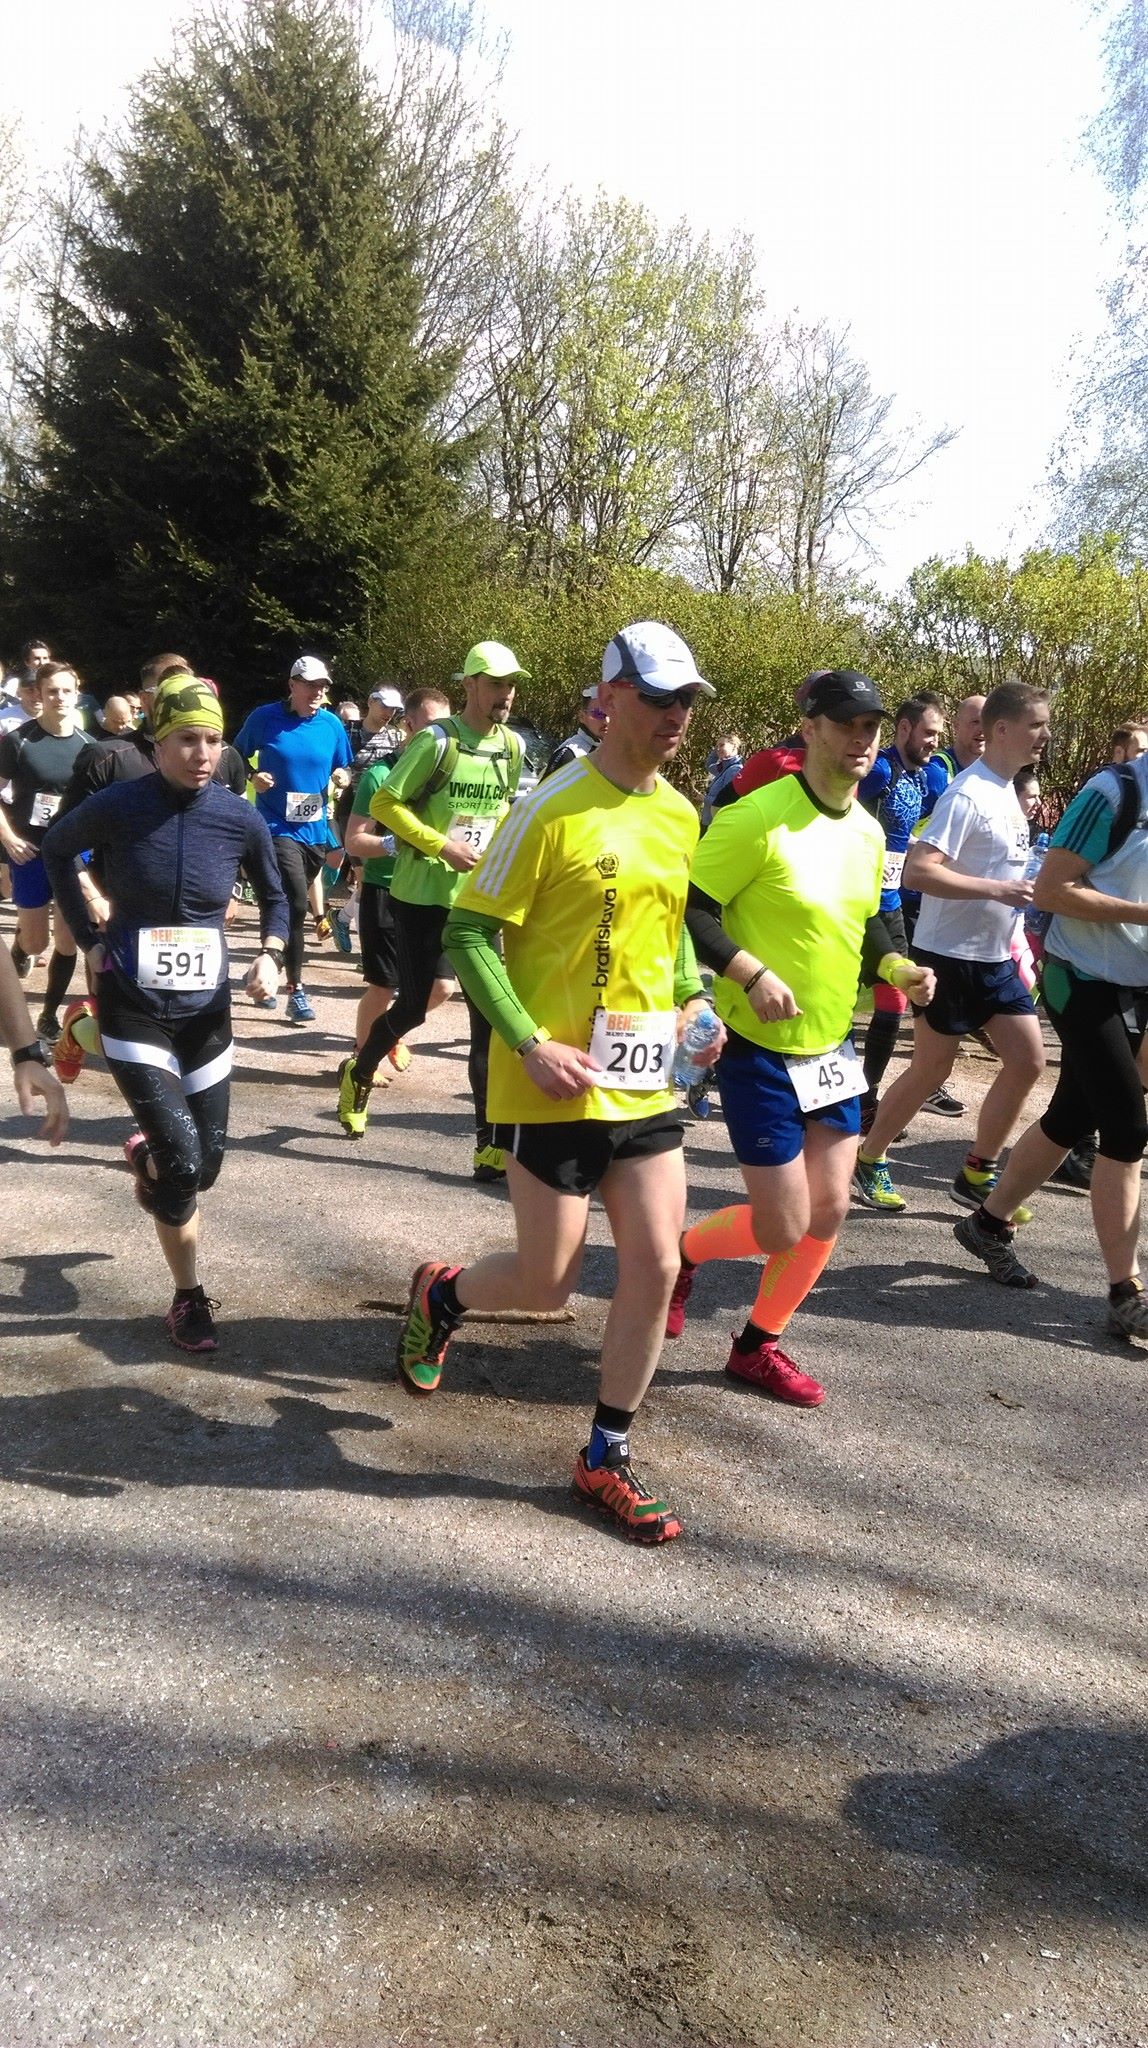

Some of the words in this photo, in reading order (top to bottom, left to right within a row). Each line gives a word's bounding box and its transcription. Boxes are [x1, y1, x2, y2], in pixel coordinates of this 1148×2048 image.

[295, 805, 318, 817] 189
[448, 801, 481, 810] SPORT
[592, 888, 617, 987] bratislava
[155, 951, 206, 977] 591
[606, 1042, 663, 1074] 203
[818, 1061, 844, 1090] 45
